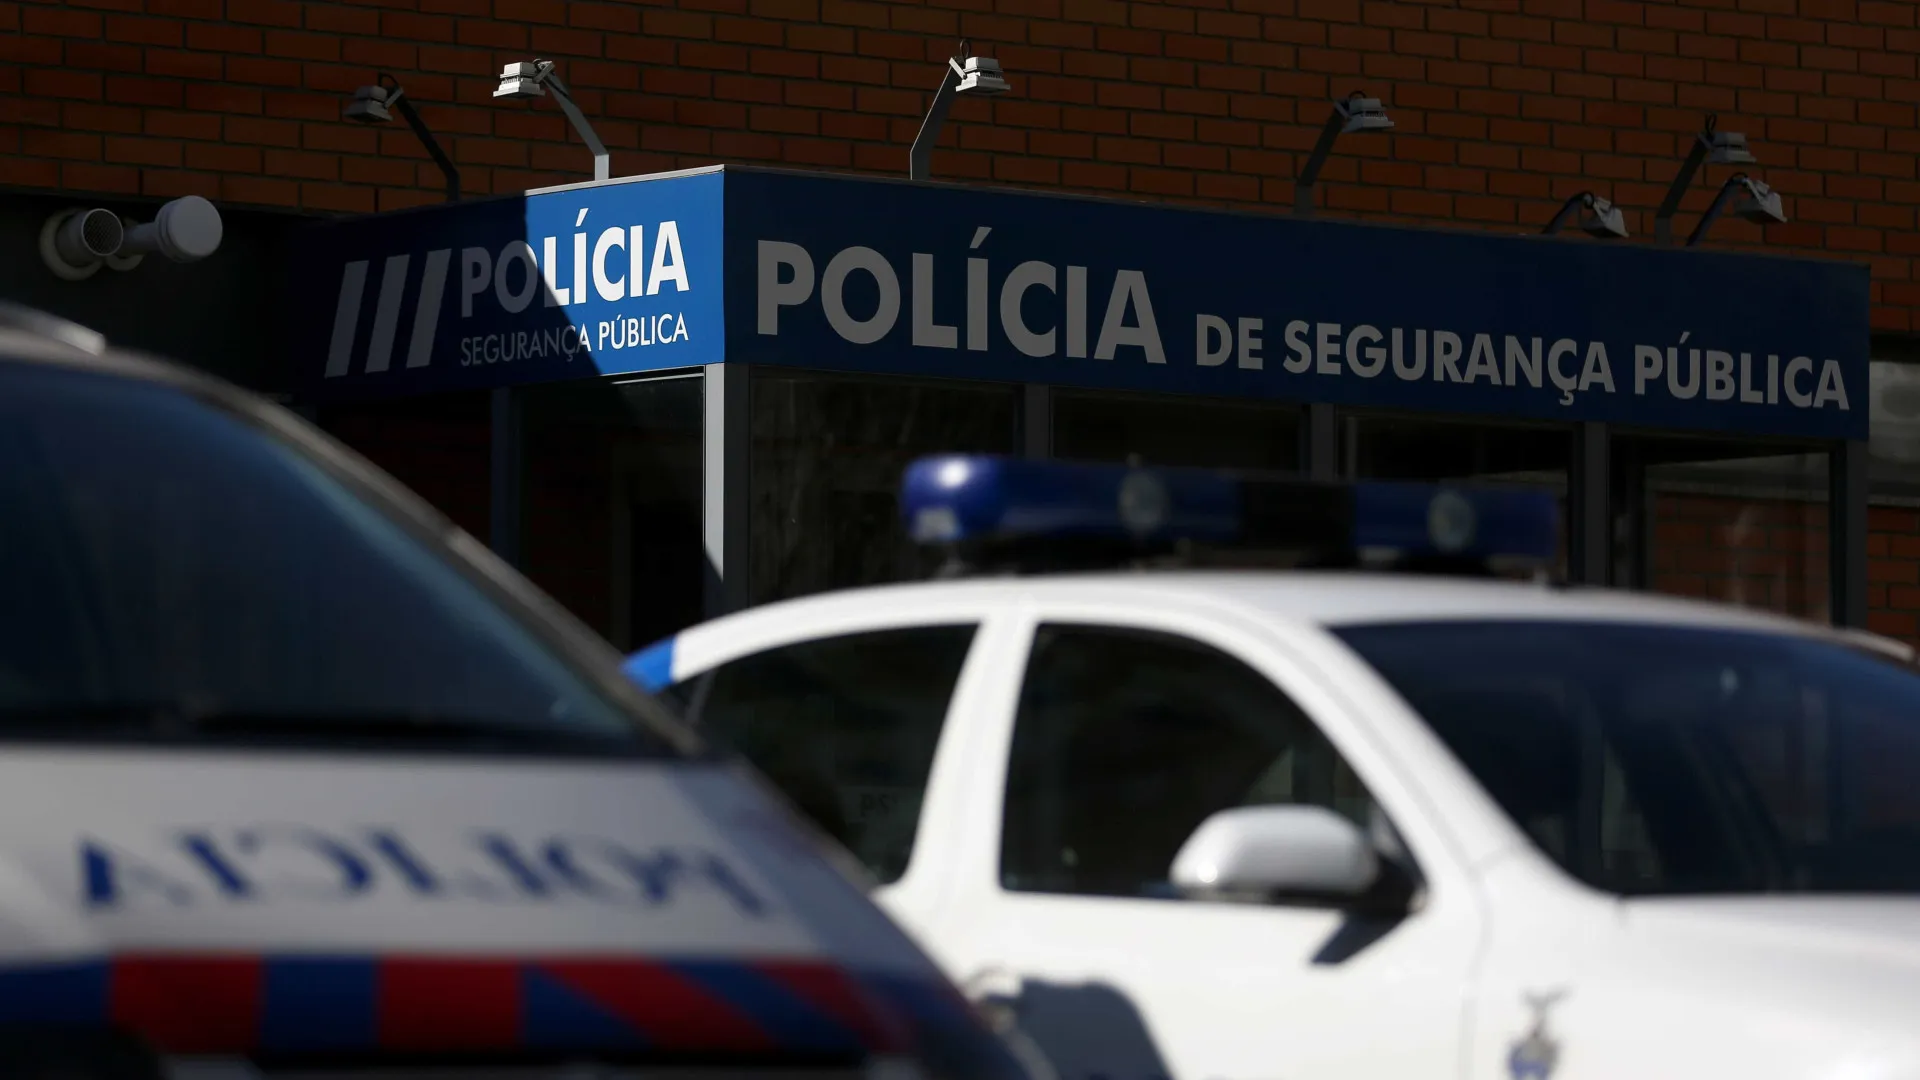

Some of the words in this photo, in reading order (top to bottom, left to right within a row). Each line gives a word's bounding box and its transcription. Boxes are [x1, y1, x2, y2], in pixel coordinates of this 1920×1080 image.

[460, 207, 690, 318] POLÍCIA
[460, 323, 592, 367] SEGURANÇA
[598, 312, 689, 351] PÚBLICA
[757, 226, 1167, 364] POLÍCIA
[1196, 314, 1263, 369] DE
[1282, 320, 1615, 405] SEGURANÇA
[1634, 331, 1850, 411] PÚBLICA
